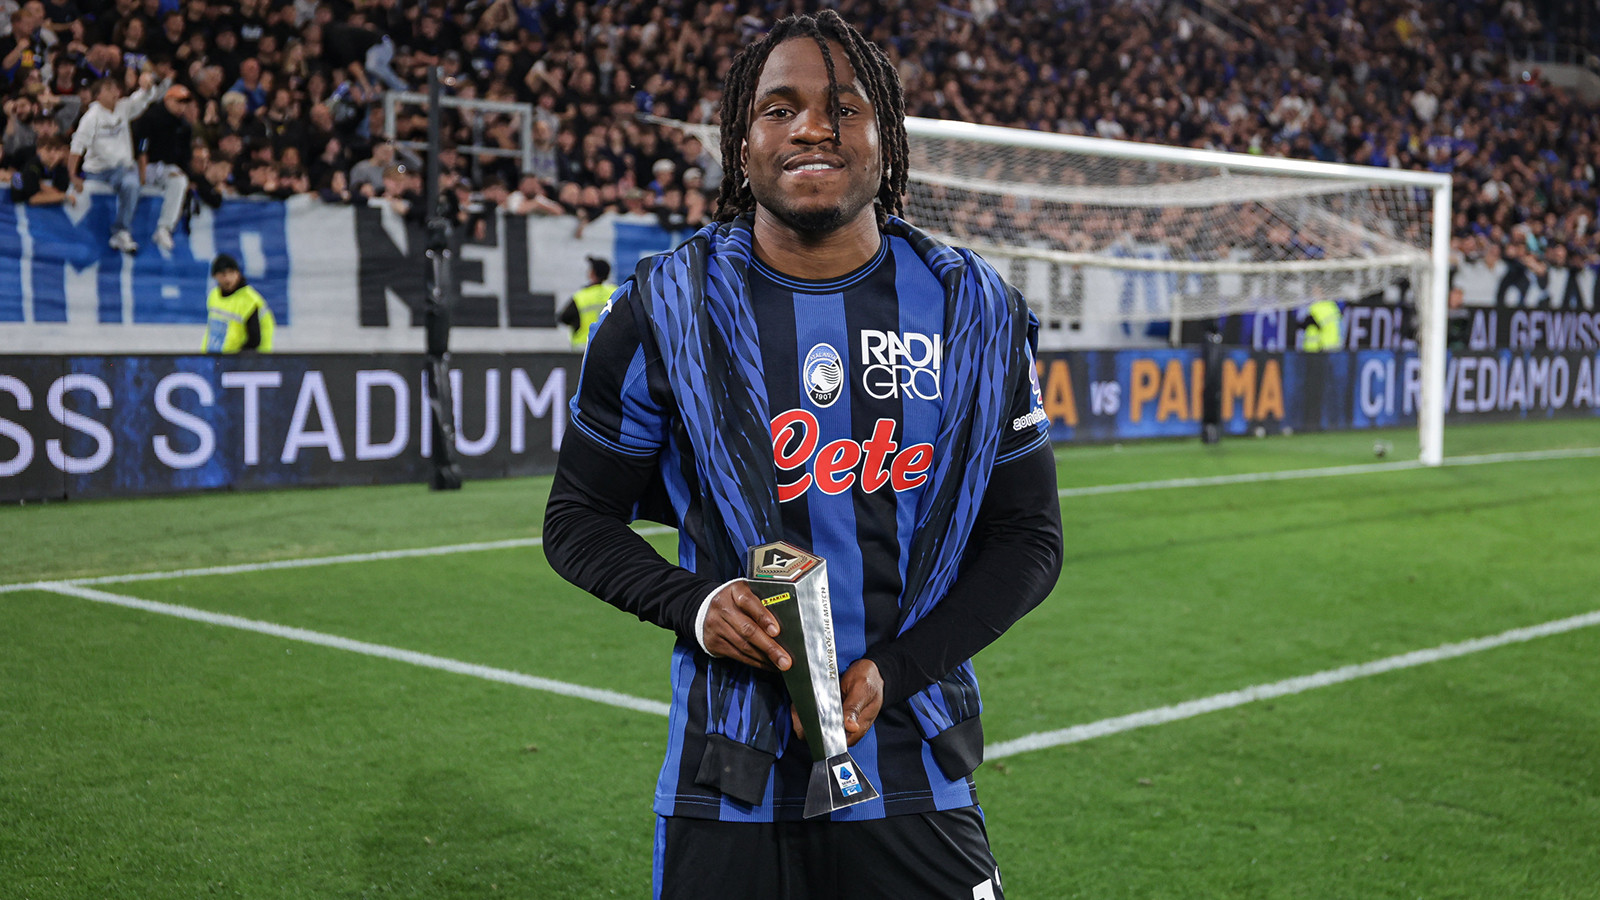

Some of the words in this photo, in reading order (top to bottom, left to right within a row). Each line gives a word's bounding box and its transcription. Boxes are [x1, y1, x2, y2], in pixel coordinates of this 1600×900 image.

[354, 205, 558, 328] NEL
[860, 329, 944, 370] RADI
[815, 393, 832, 401] 1907
[1360, 358, 1396, 418] CI
[1403, 355, 1570, 415] RVEDIAMO
[153, 367, 567, 470] STADIUM
[820, 587, 830, 618] MATCH
[823, 618, 831, 635] THE
[826, 647, 836, 680] PLAYER
